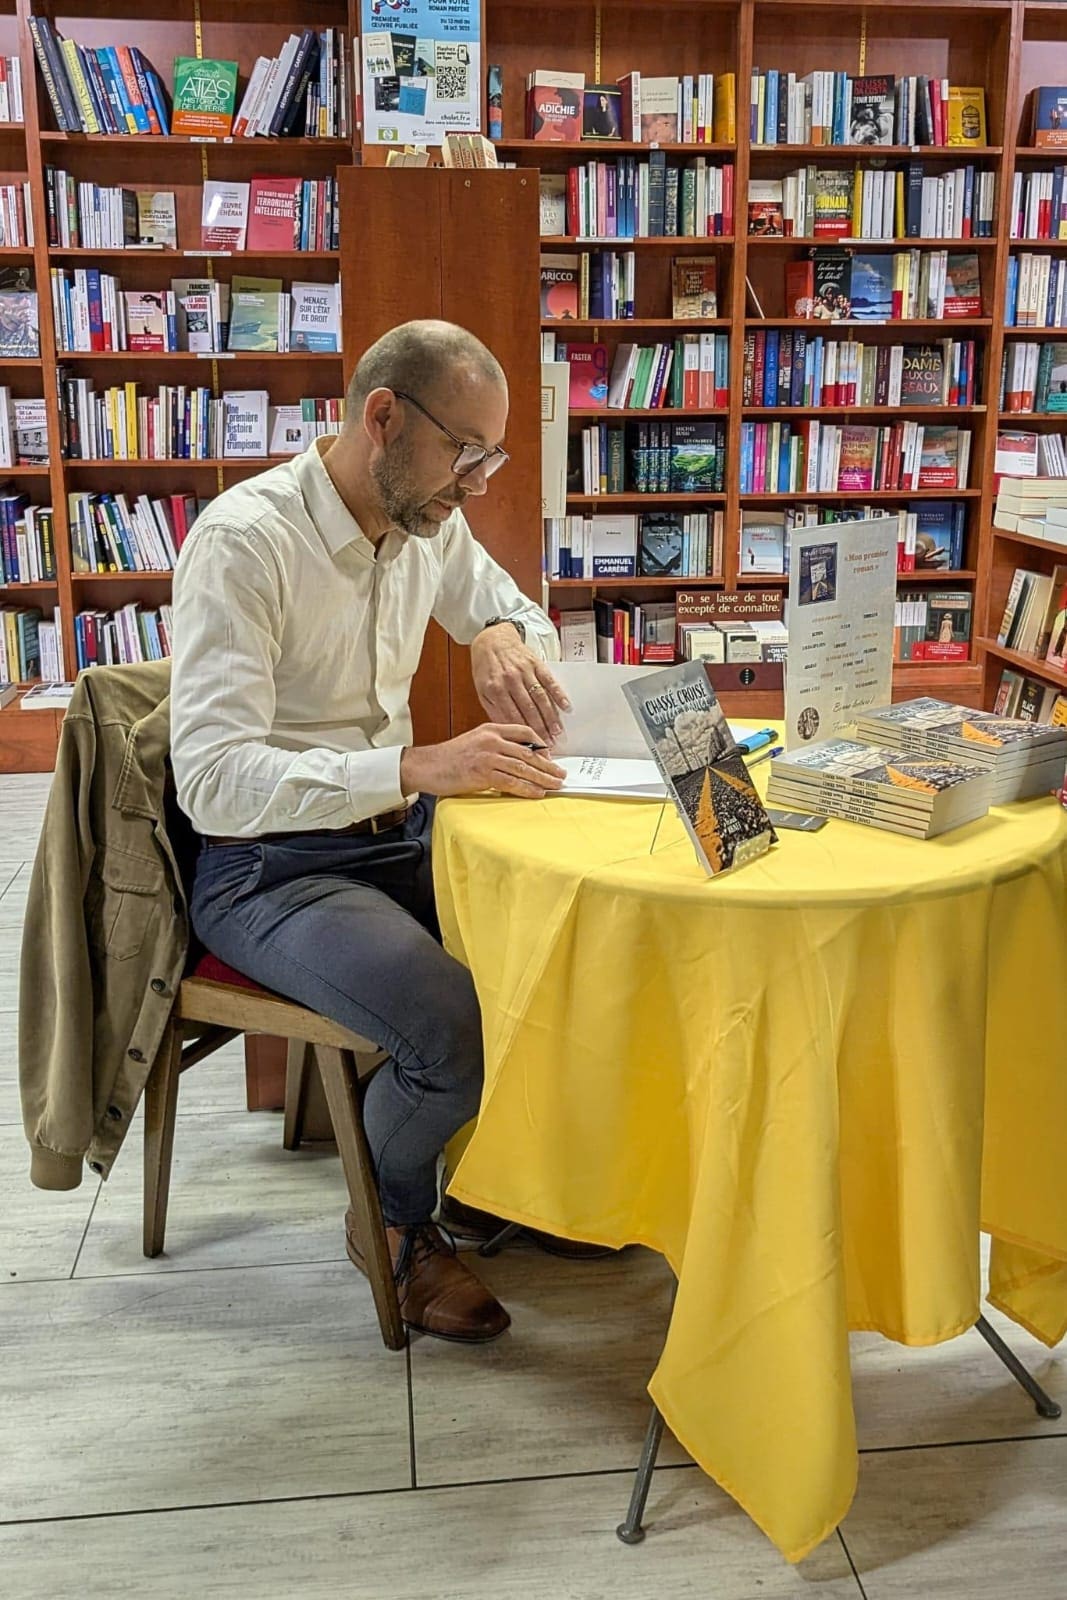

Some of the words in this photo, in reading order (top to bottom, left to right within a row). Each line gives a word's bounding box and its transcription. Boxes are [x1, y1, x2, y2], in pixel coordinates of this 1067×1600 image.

[180, 76, 231, 100] ATLAS
[184, 97, 226, 106] HISTORIQUE
[539, 103, 575, 115] ADICHIE
[257, 197, 294, 208] TERRORISME
[254, 206, 296, 218] INTELLECTUEL
[541, 271, 573, 281] ARICCO
[303, 296, 328, 305] MENACE
[310, 314, 328, 323] DROIT
[571, 353, 592, 361] FASTER
[920, 346, 932, 357] LA
[864, 550, 889, 560] premier
[598, 565, 629, 573] CARRÈRE
[678, 594, 694, 604] On
[700, 595, 710, 603] se
[716, 593, 738, 603] lasse
[744, 592, 756, 602] de
[762, 593, 780, 602] tout
[678, 603, 715, 616] excepté
[719, 603, 730, 613] de
[733, 603, 780, 613] connaître.
[645, 689, 678, 716] CHASSÉ
[677, 679, 707, 705] CROISÉ
